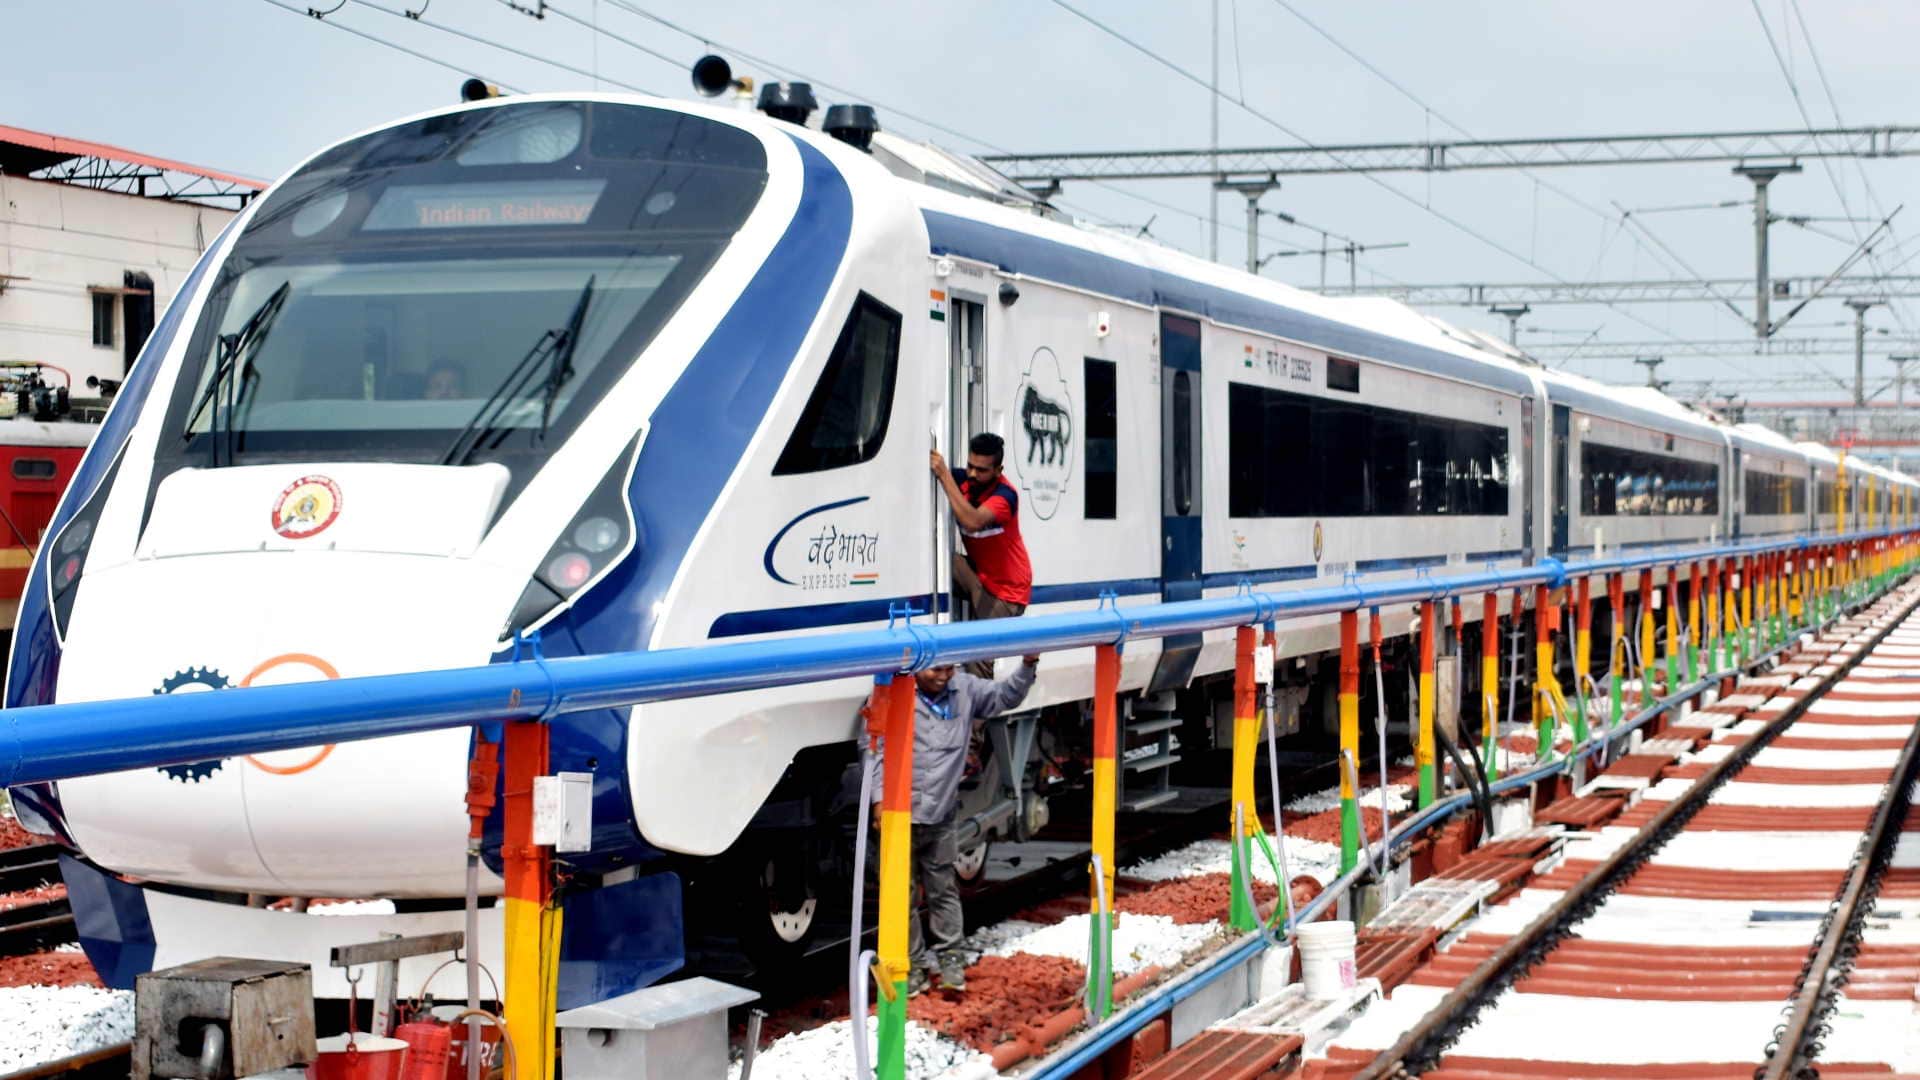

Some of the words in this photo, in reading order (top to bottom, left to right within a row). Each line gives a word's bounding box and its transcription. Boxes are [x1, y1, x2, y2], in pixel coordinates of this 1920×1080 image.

[420, 203, 491, 224] Indian
[501, 201, 593, 223] Railway
[801, 573, 847, 590] EXPRESS
